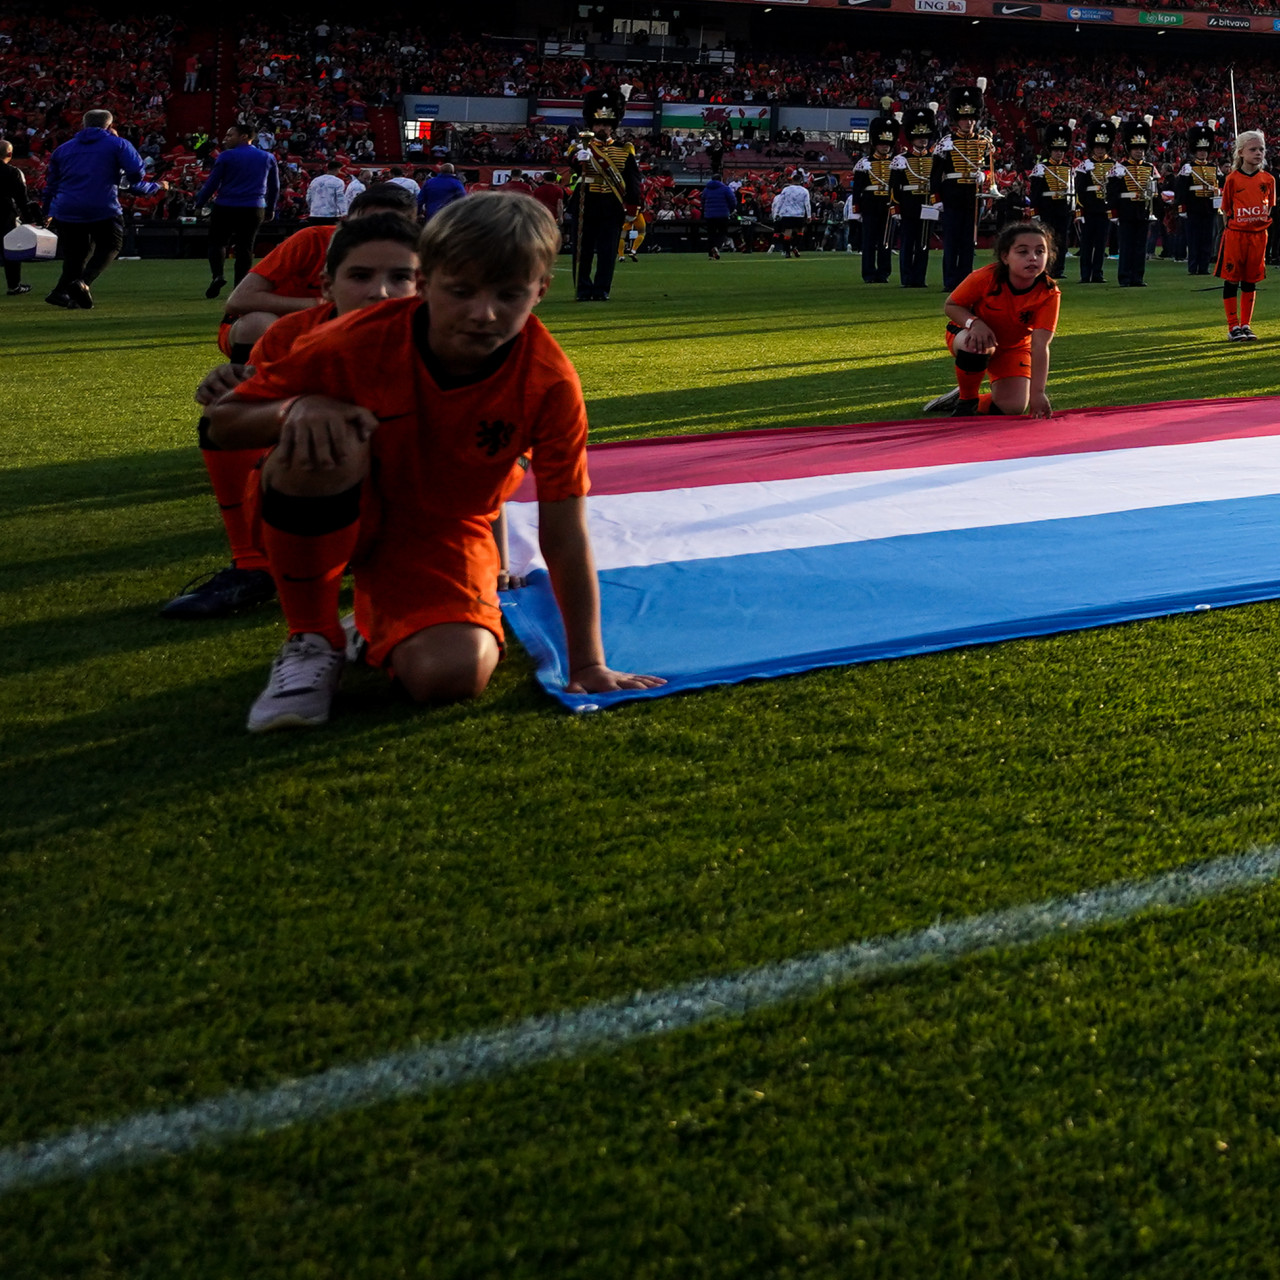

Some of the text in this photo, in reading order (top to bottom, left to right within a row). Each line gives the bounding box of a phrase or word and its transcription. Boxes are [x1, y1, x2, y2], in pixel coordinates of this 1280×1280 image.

[918, 0, 944, 11] ING
[1158, 14, 1176, 24] kpn
[1219, 19, 1249, 28] bitvavo
[1237, 206, 1260, 217] ING
